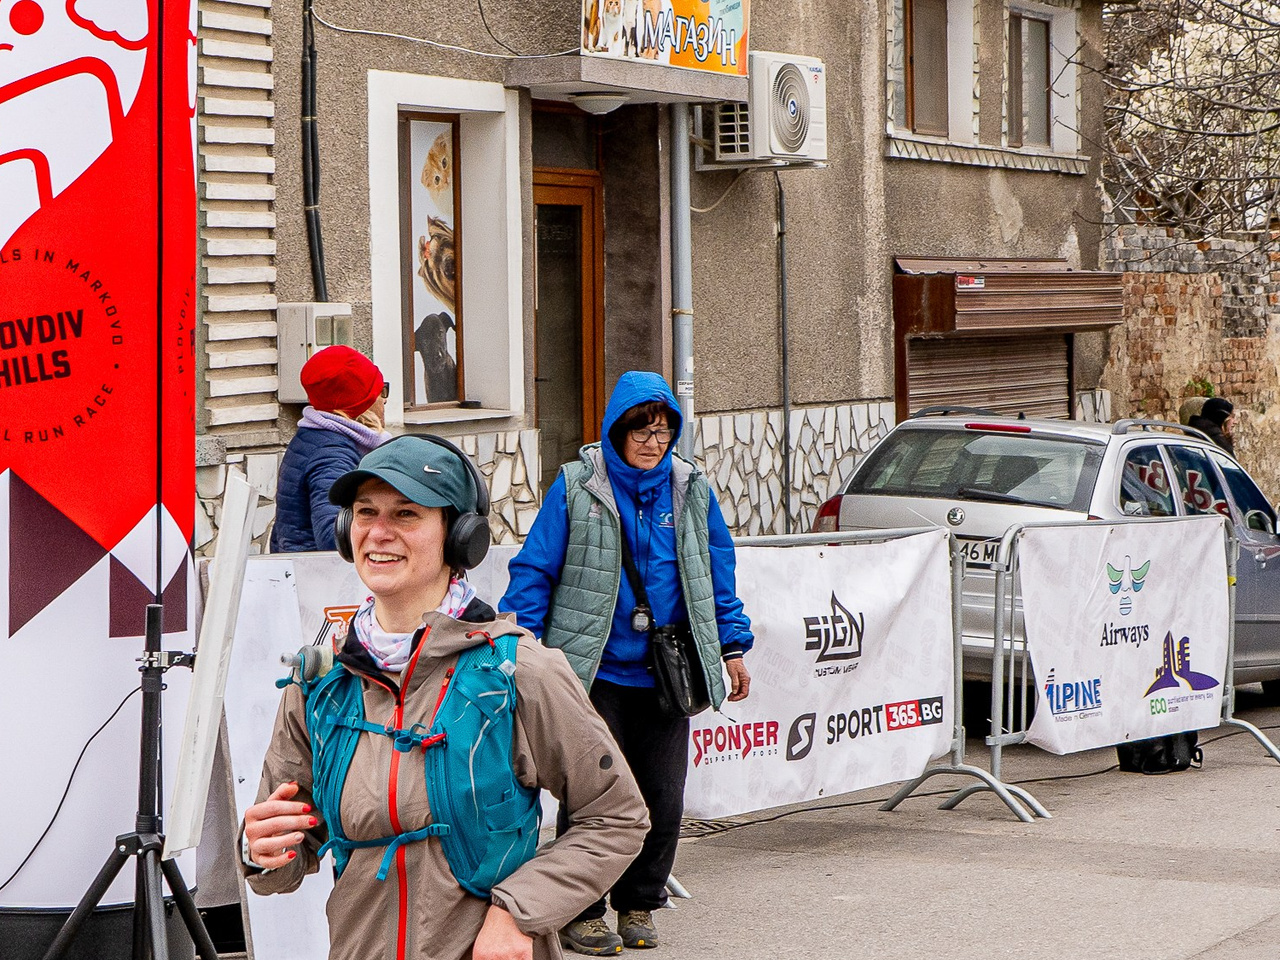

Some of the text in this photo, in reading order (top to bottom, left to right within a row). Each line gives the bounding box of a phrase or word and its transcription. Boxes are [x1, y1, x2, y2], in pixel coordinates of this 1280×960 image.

[644, 8, 738, 66] МАГАЗИН
[34, 248, 55, 263] IN
[65, 258, 124, 345] MARKOVO
[24, 427, 65, 443] RUN
[72, 382, 114, 428] RACE
[1100, 622, 1150, 648] Airways
[1150, 698, 1167, 715] ECO
[692, 720, 780, 768] SPONSER
[709, 753, 739, 764] SPORT
